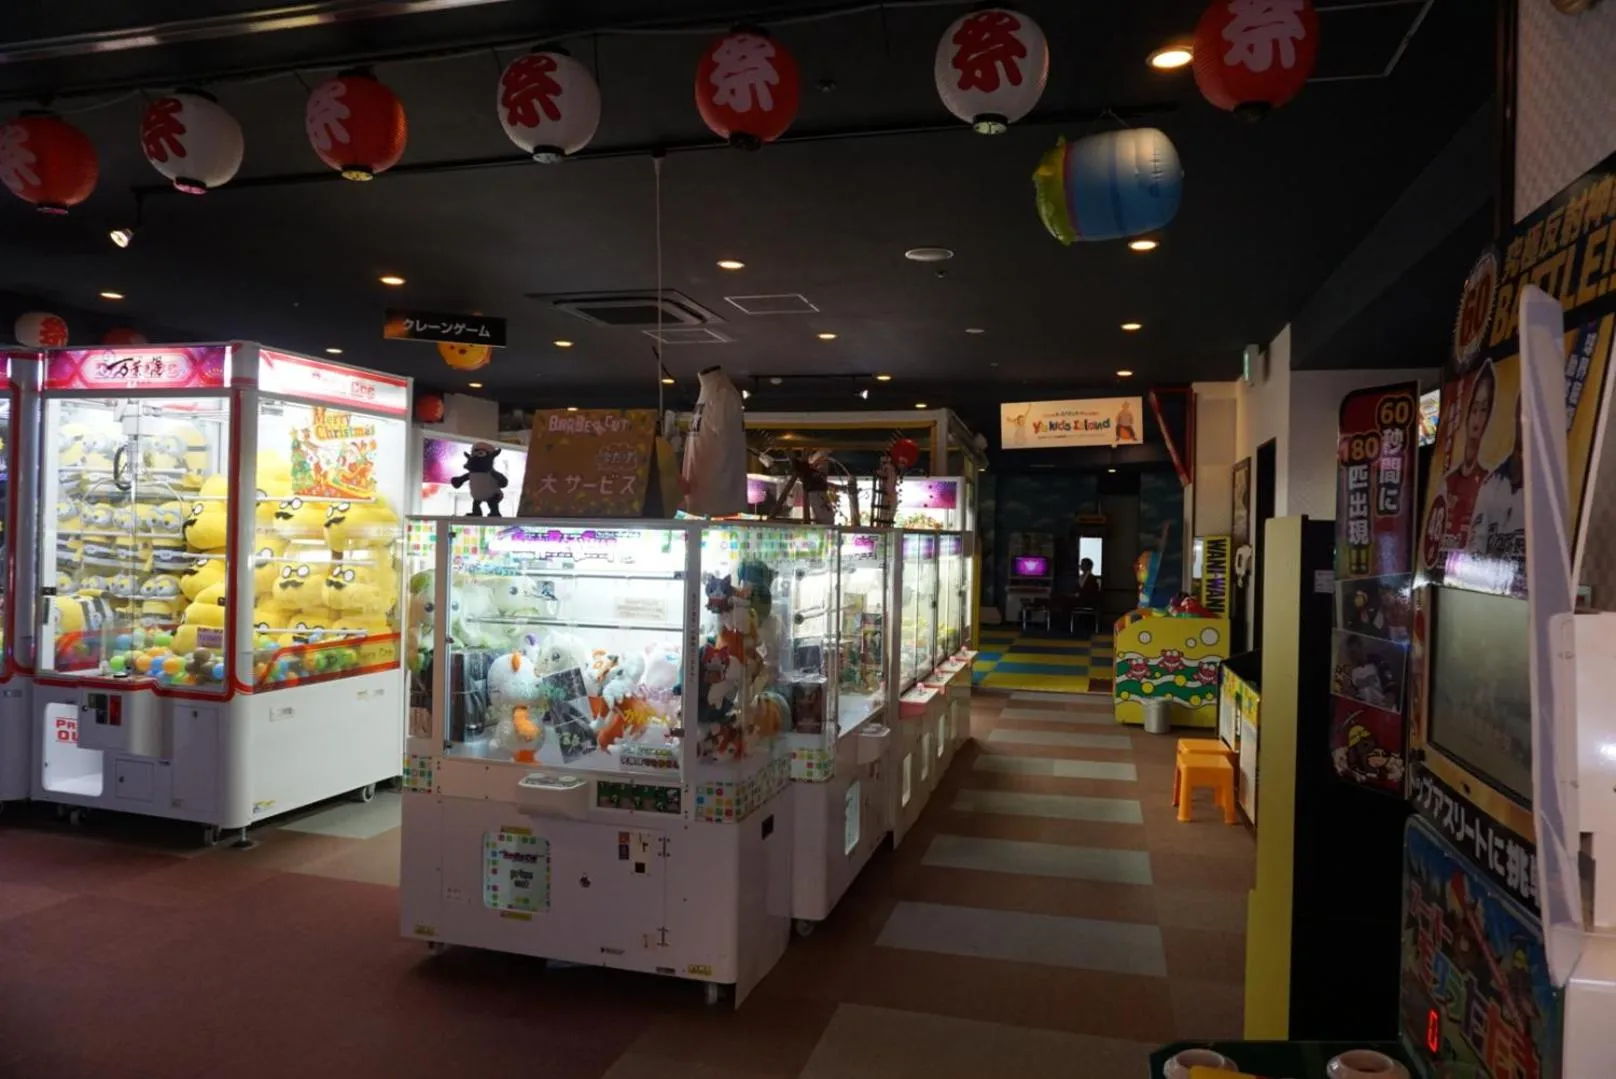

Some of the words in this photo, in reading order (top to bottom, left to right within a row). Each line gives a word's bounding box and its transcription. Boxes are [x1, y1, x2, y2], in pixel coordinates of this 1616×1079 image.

[709, 30, 780, 113] 祭
[951, 12, 1027, 92] 祭
[1221, 0, 1306, 72] 祭
[501, 54, 562, 127] 祭
[403, 318, 492, 339] クレーンゲーム
